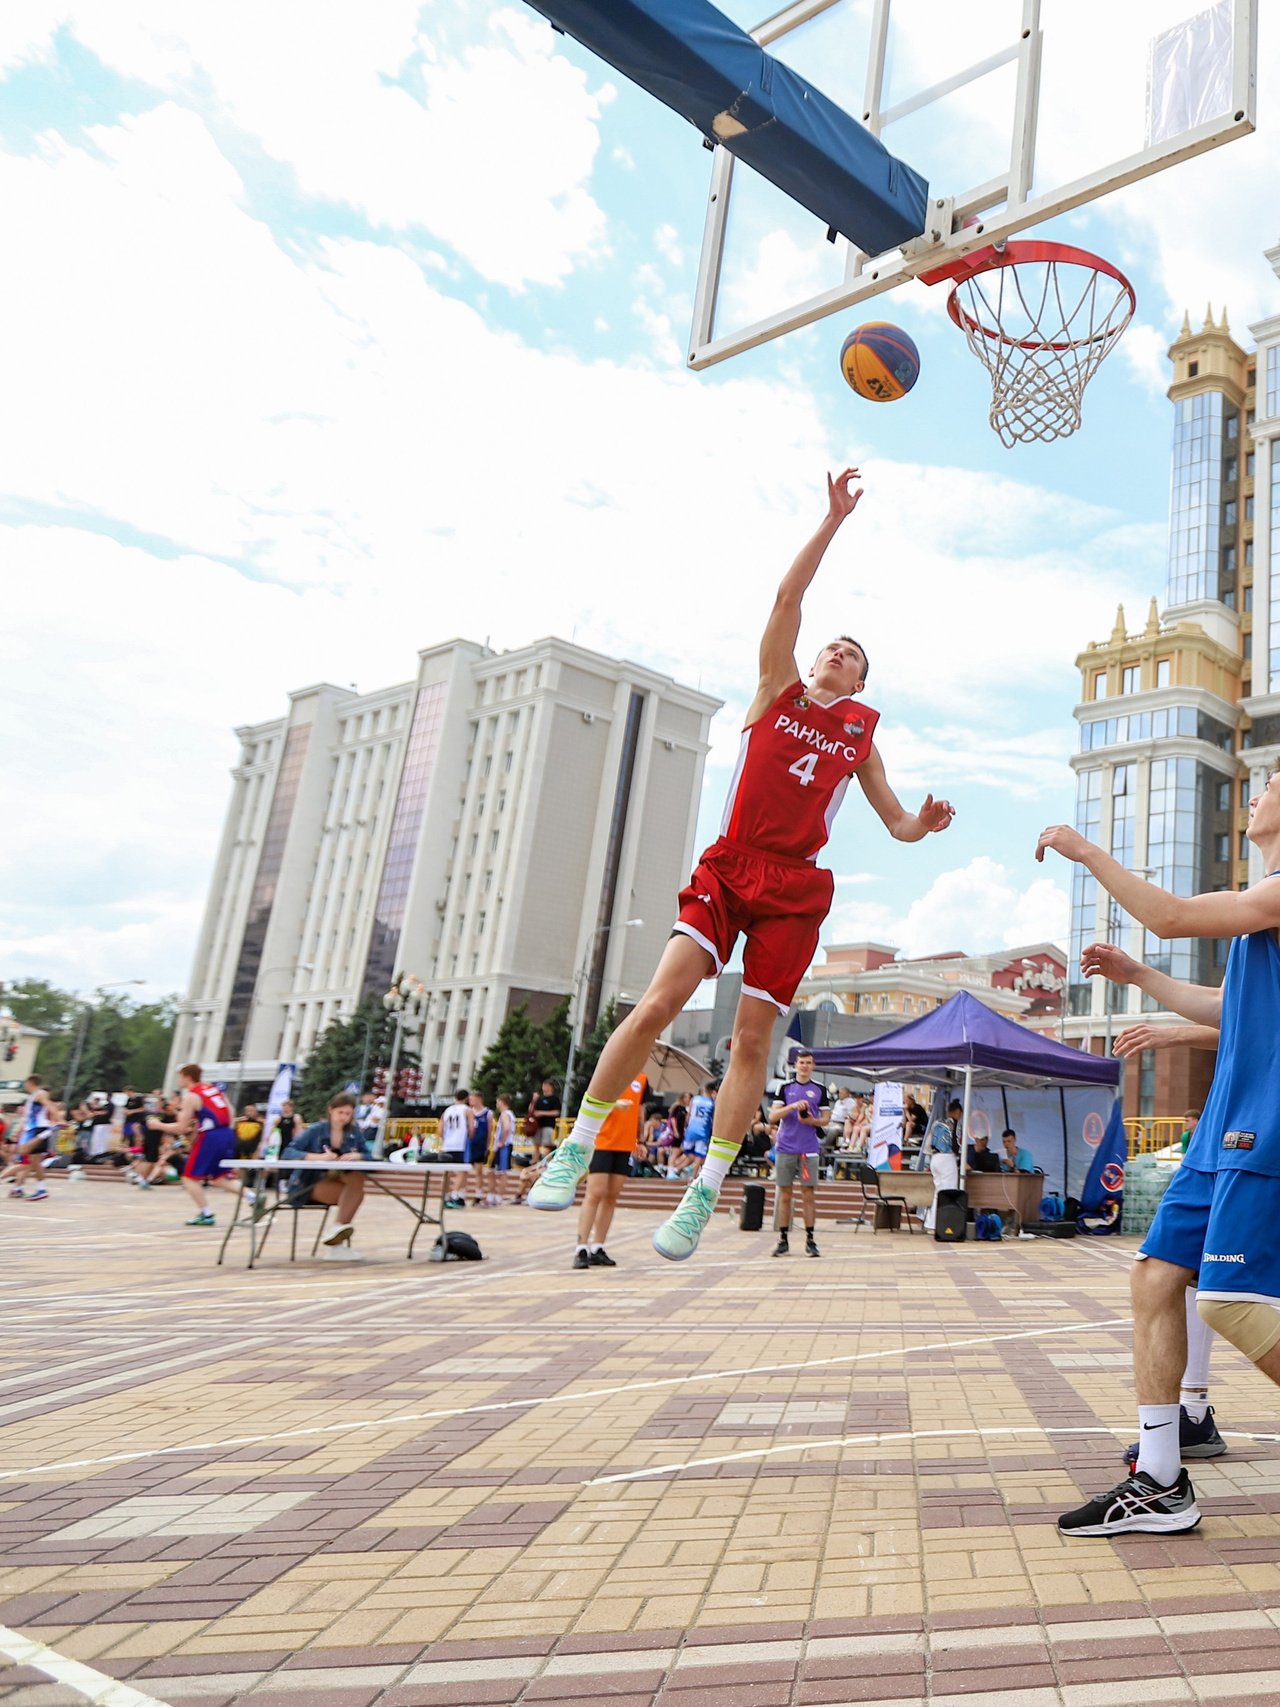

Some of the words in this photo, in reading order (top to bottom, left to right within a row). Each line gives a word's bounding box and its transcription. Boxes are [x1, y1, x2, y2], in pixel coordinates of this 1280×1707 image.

[774, 714, 857, 761] РАНХиГС
[788, 752, 820, 787] 4
[1203, 1253, 1246, 1265] SPALDING
